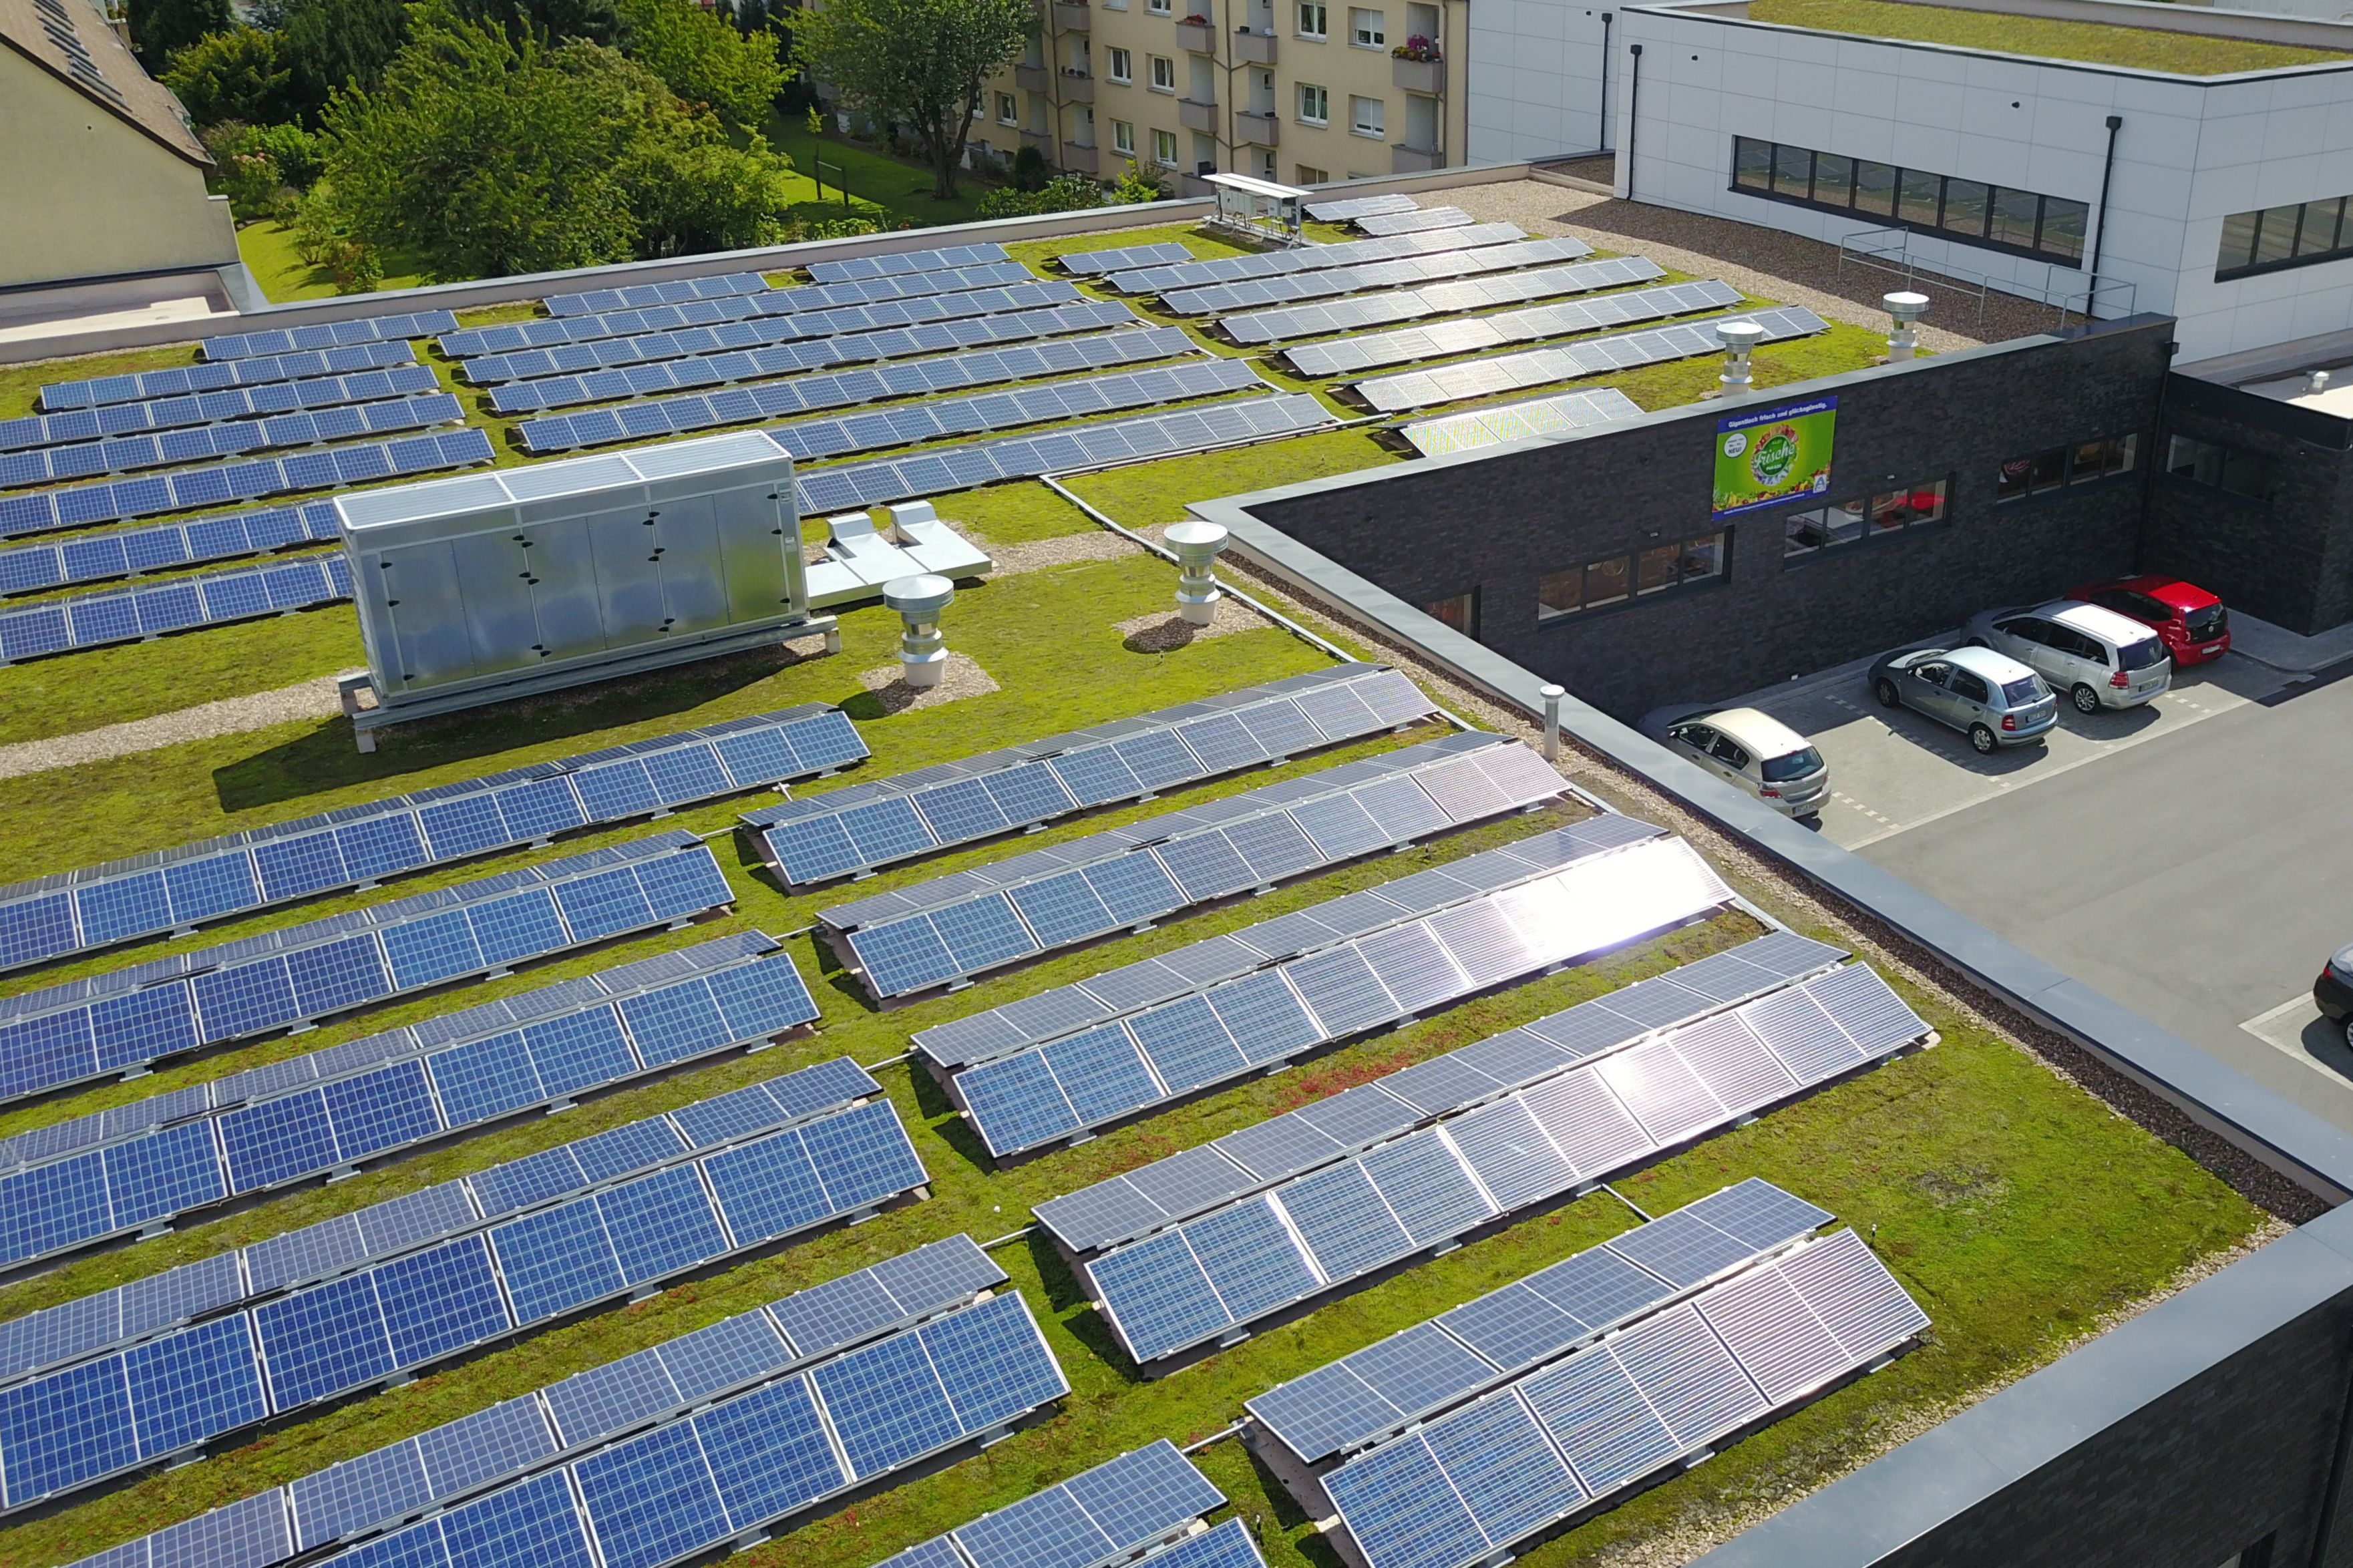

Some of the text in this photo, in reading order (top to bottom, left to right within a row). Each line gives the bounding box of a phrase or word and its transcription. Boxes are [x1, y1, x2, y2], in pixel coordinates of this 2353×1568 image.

[1729, 417, 1758, 427] Gigantisch
[1759, 413, 1776, 421] frisch
[1755, 441, 1795, 468] Frische
